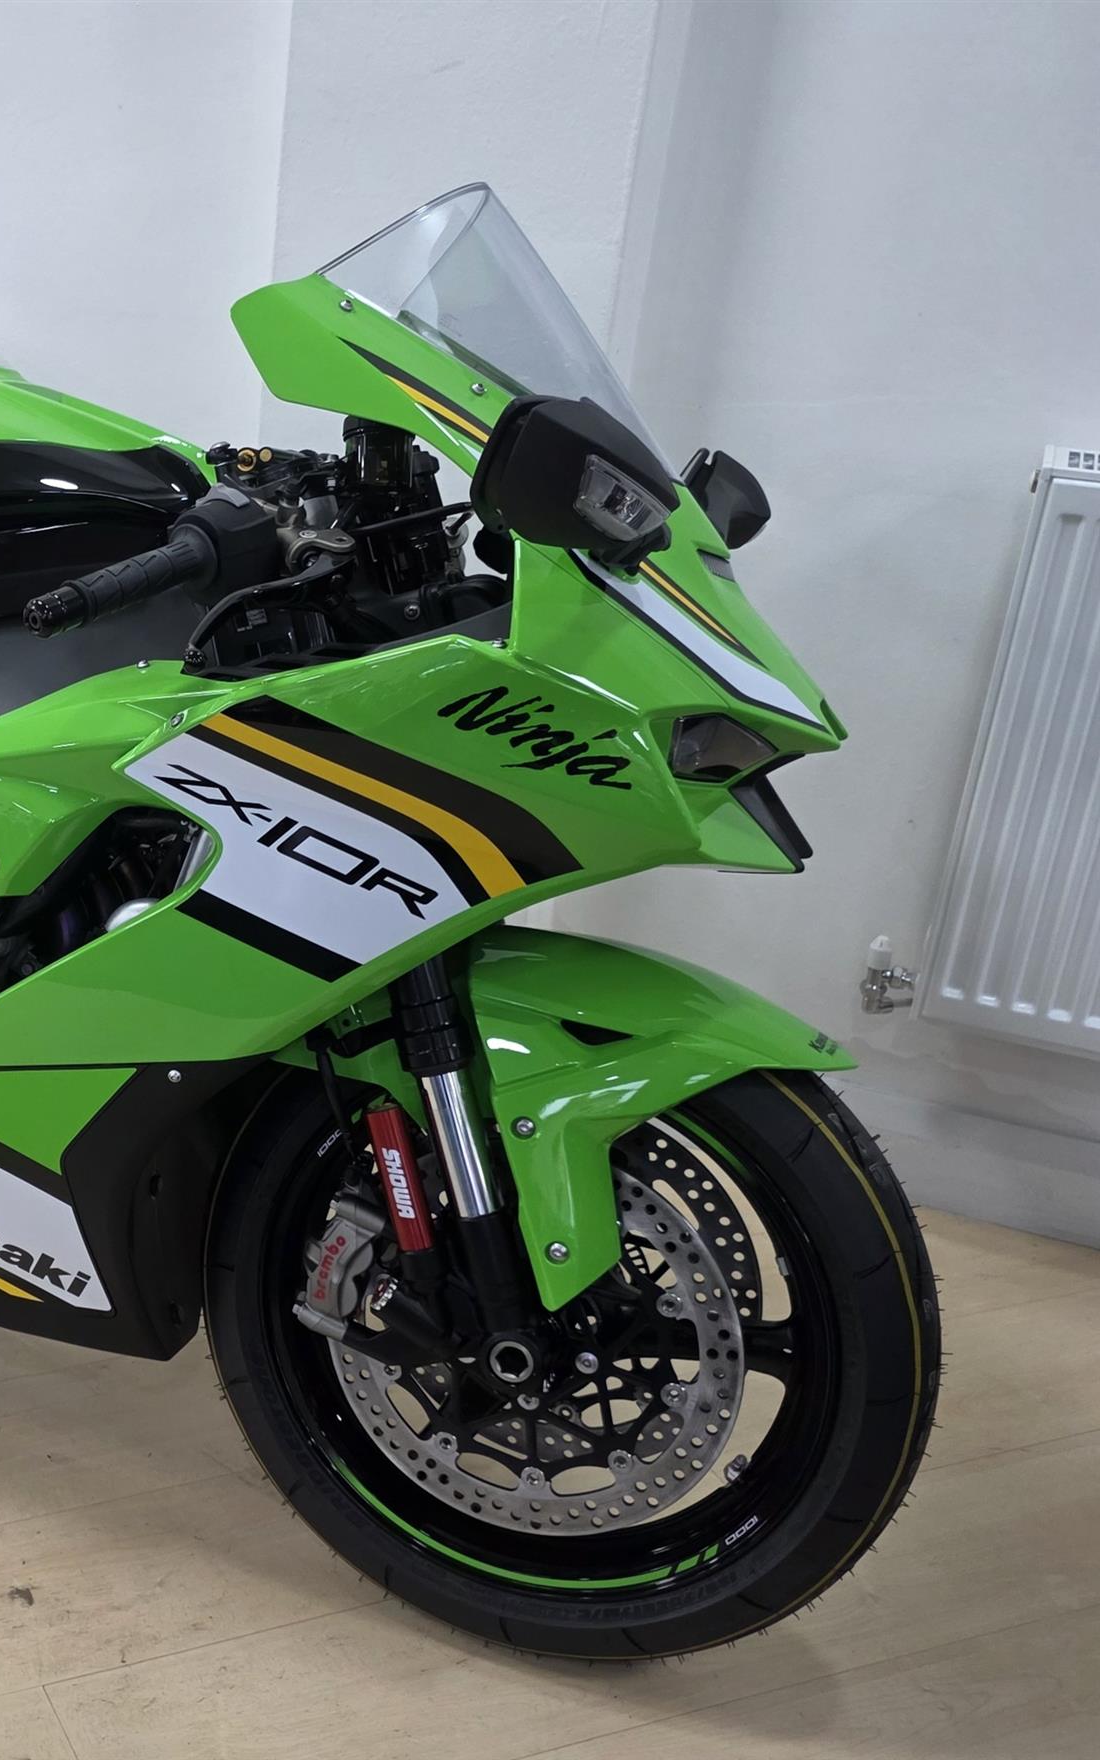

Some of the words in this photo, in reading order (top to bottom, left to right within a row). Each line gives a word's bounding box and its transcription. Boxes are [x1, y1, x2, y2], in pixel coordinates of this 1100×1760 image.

[436, 685, 633, 791] Ninja
[153, 763, 439, 920] ZX-10R
[381, 1147, 416, 1219] SHOWA
[314, 1235, 346, 1301] brembo
